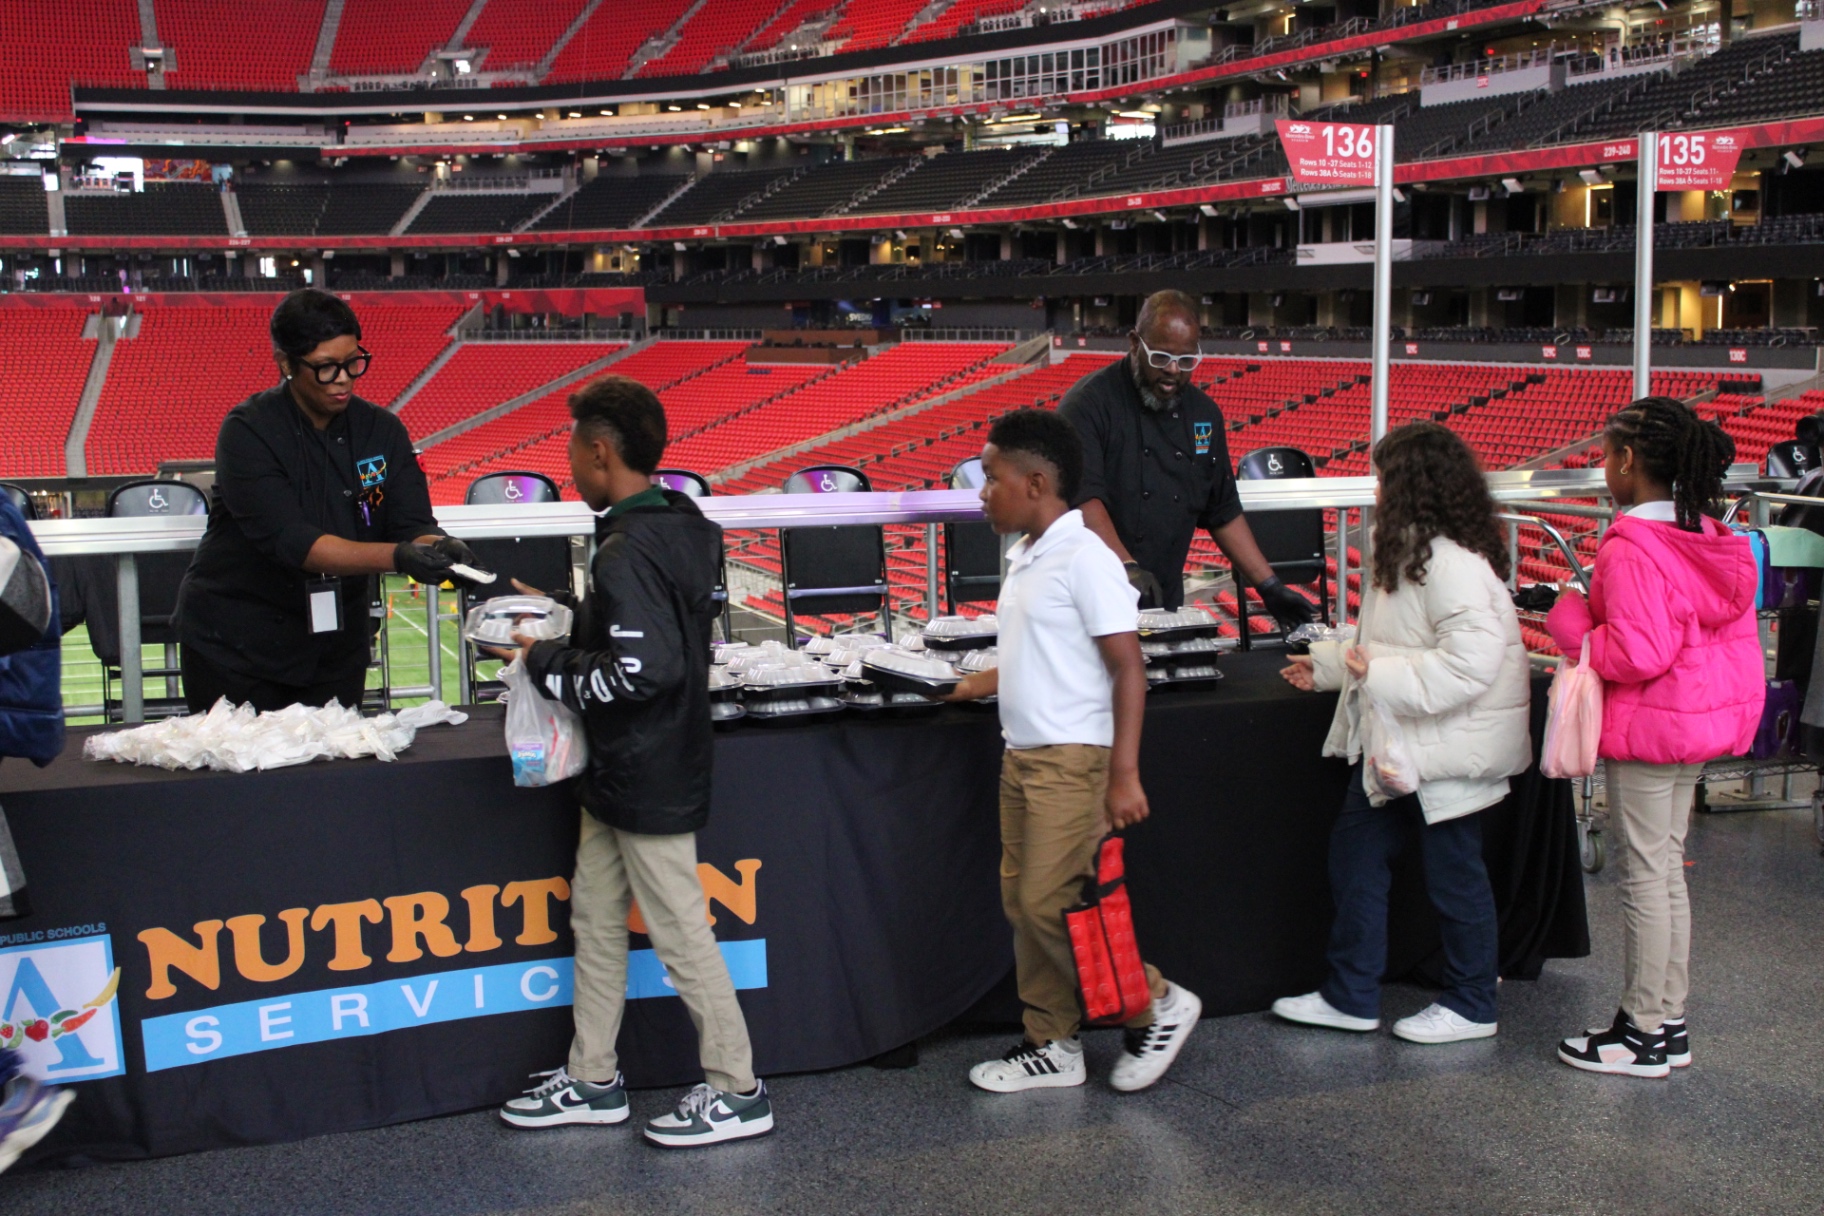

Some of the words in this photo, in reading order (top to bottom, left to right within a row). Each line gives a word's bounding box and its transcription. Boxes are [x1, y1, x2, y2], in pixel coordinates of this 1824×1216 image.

[1322, 125, 1373, 158] 136
[1603, 144, 1631, 158] 239-240
[1659, 135, 1705, 165] 135
[1299, 157, 1317, 167] Rows
[1318, 158, 1326, 167] 10
[1339, 160, 1357, 168] Seats
[1358, 161, 1373, 169] 1-12
[1300, 168, 1318, 177] Rows
[1319, 169, 1332, 177] 38A
[1339, 170, 1357, 179] Seats
[1358, 171, 1373, 179] 1-18
[1659, 167, 1675, 175] Rows
[1692, 167, 1709, 175] Seats
[1658, 177, 1675, 185] Rows
[1692, 177, 1709, 185] Seats
[1729, 350, 1747, 362] 130C
[0, 930, 45, 946] PUBLIC
[47, 922, 107, 939] SCHOOLS
[137, 858, 763, 1000] NUTRITN
[184, 962, 678, 1055] SERVIC
